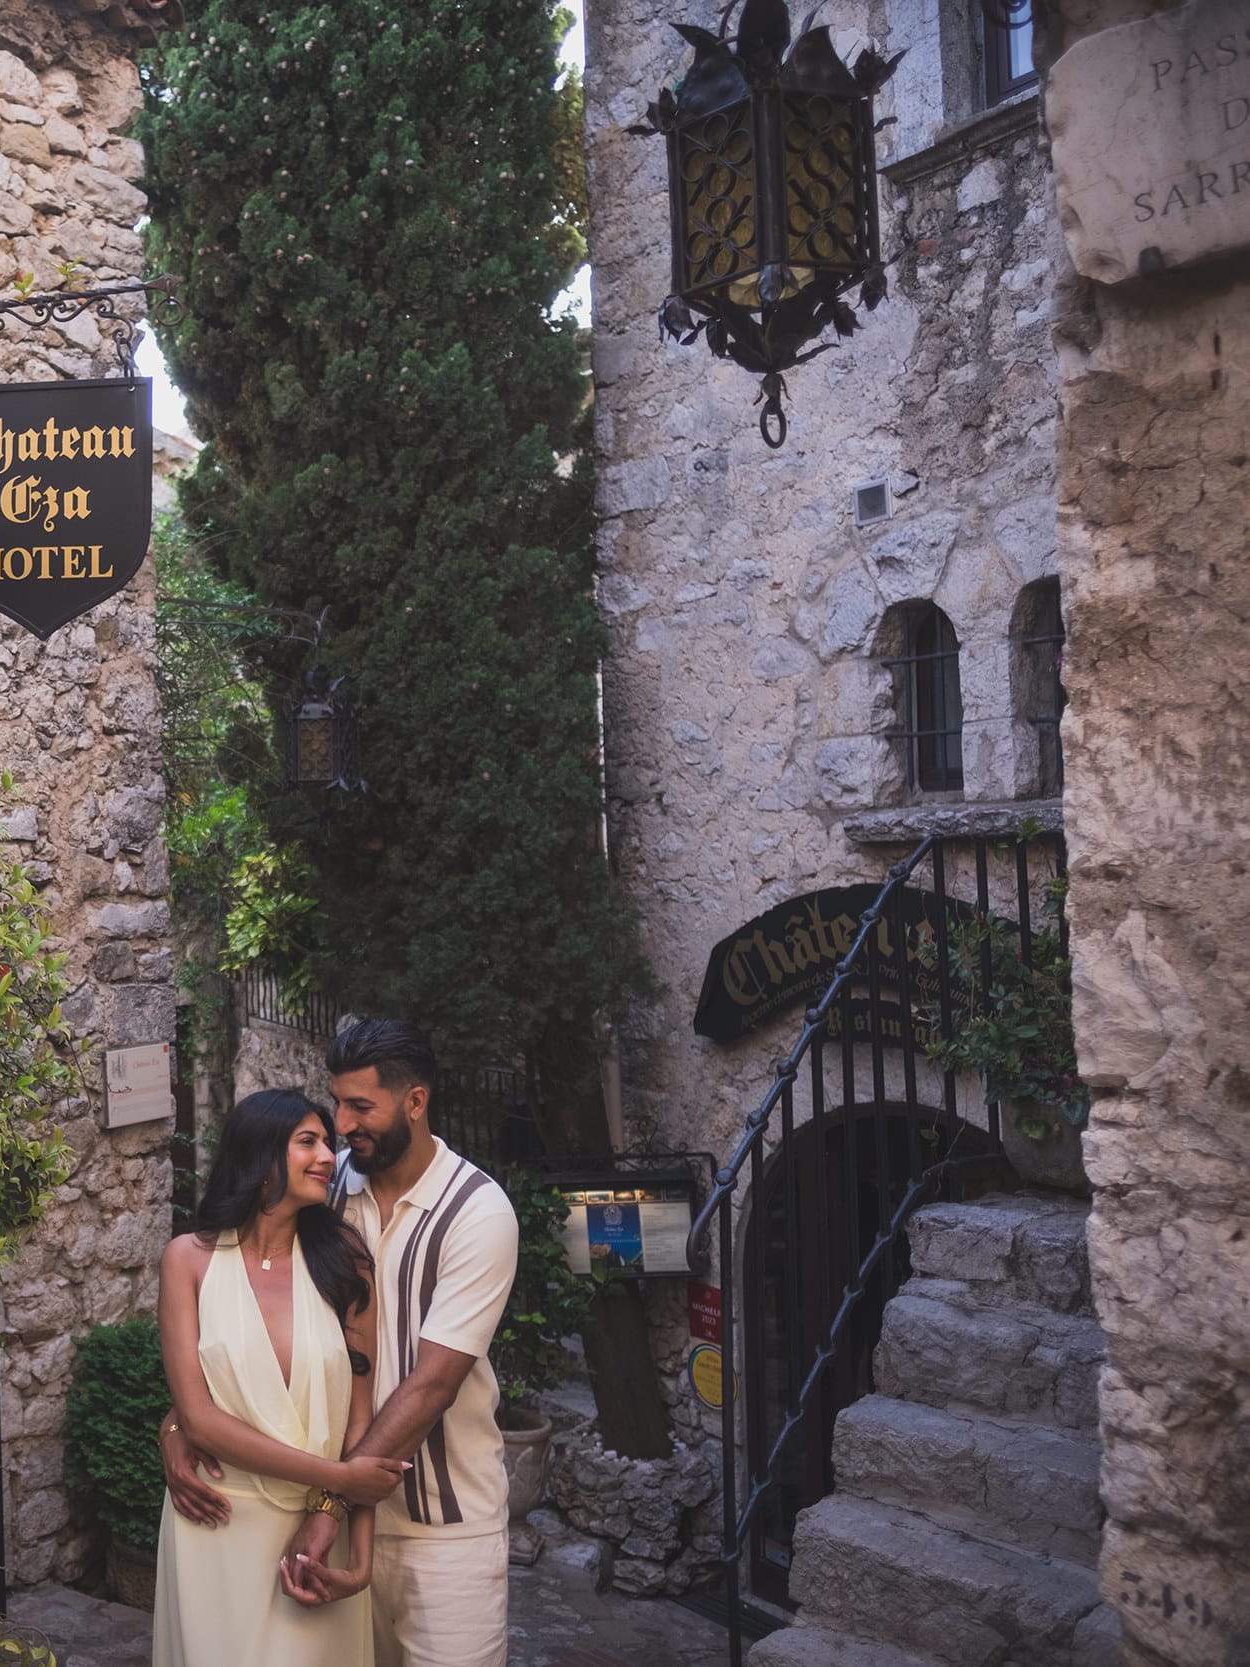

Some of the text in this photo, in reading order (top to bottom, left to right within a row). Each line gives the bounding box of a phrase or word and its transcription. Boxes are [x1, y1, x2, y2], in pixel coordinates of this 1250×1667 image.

[1151, 33, 1250, 93] PAS
[0, 474, 92, 532] Eza
[723, 896, 937, 1005] Châte
